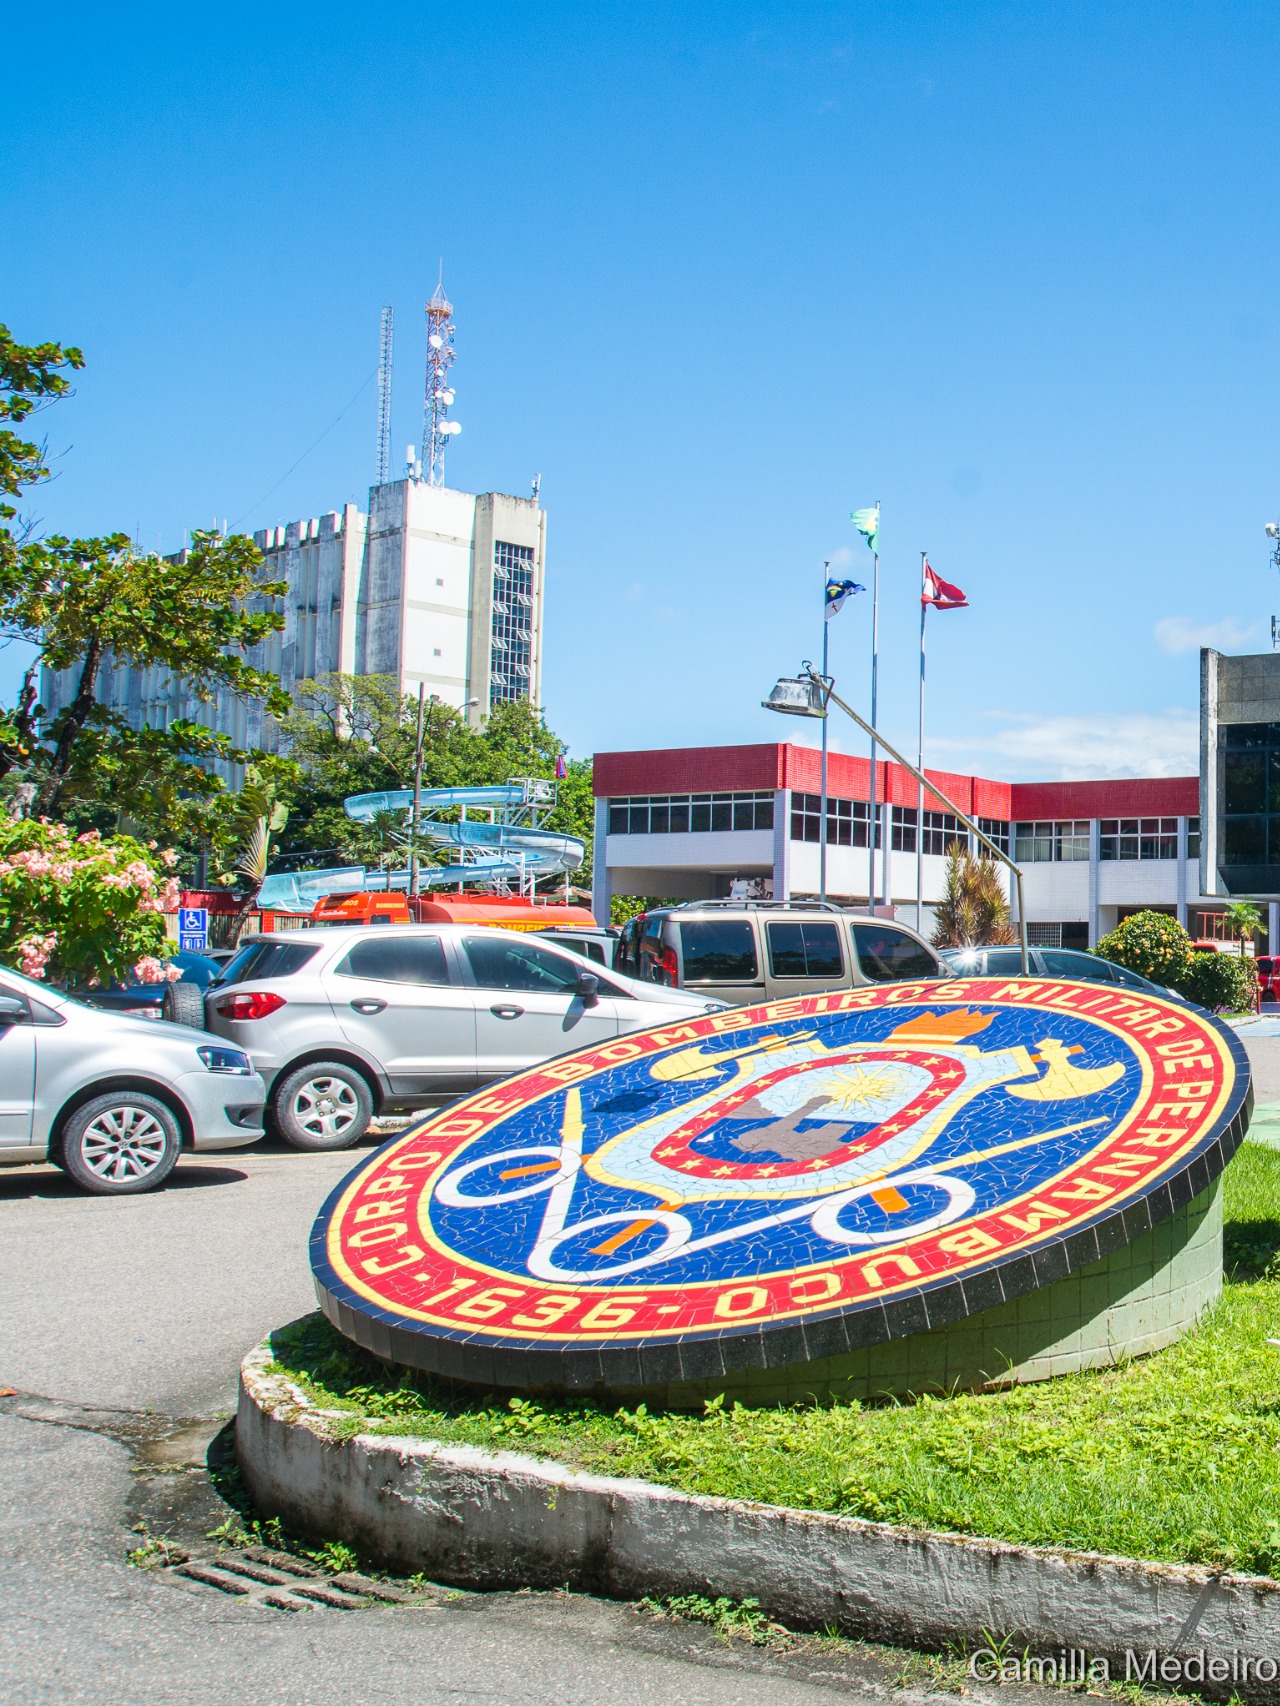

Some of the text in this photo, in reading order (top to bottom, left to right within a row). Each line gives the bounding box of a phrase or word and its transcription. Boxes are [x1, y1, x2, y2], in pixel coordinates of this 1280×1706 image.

[347, 981, 1215, 1319] CORPO DE BOMBEIROS MILITAR DE PERNAMBUCO
[422, 1277, 649, 1329] 1636
